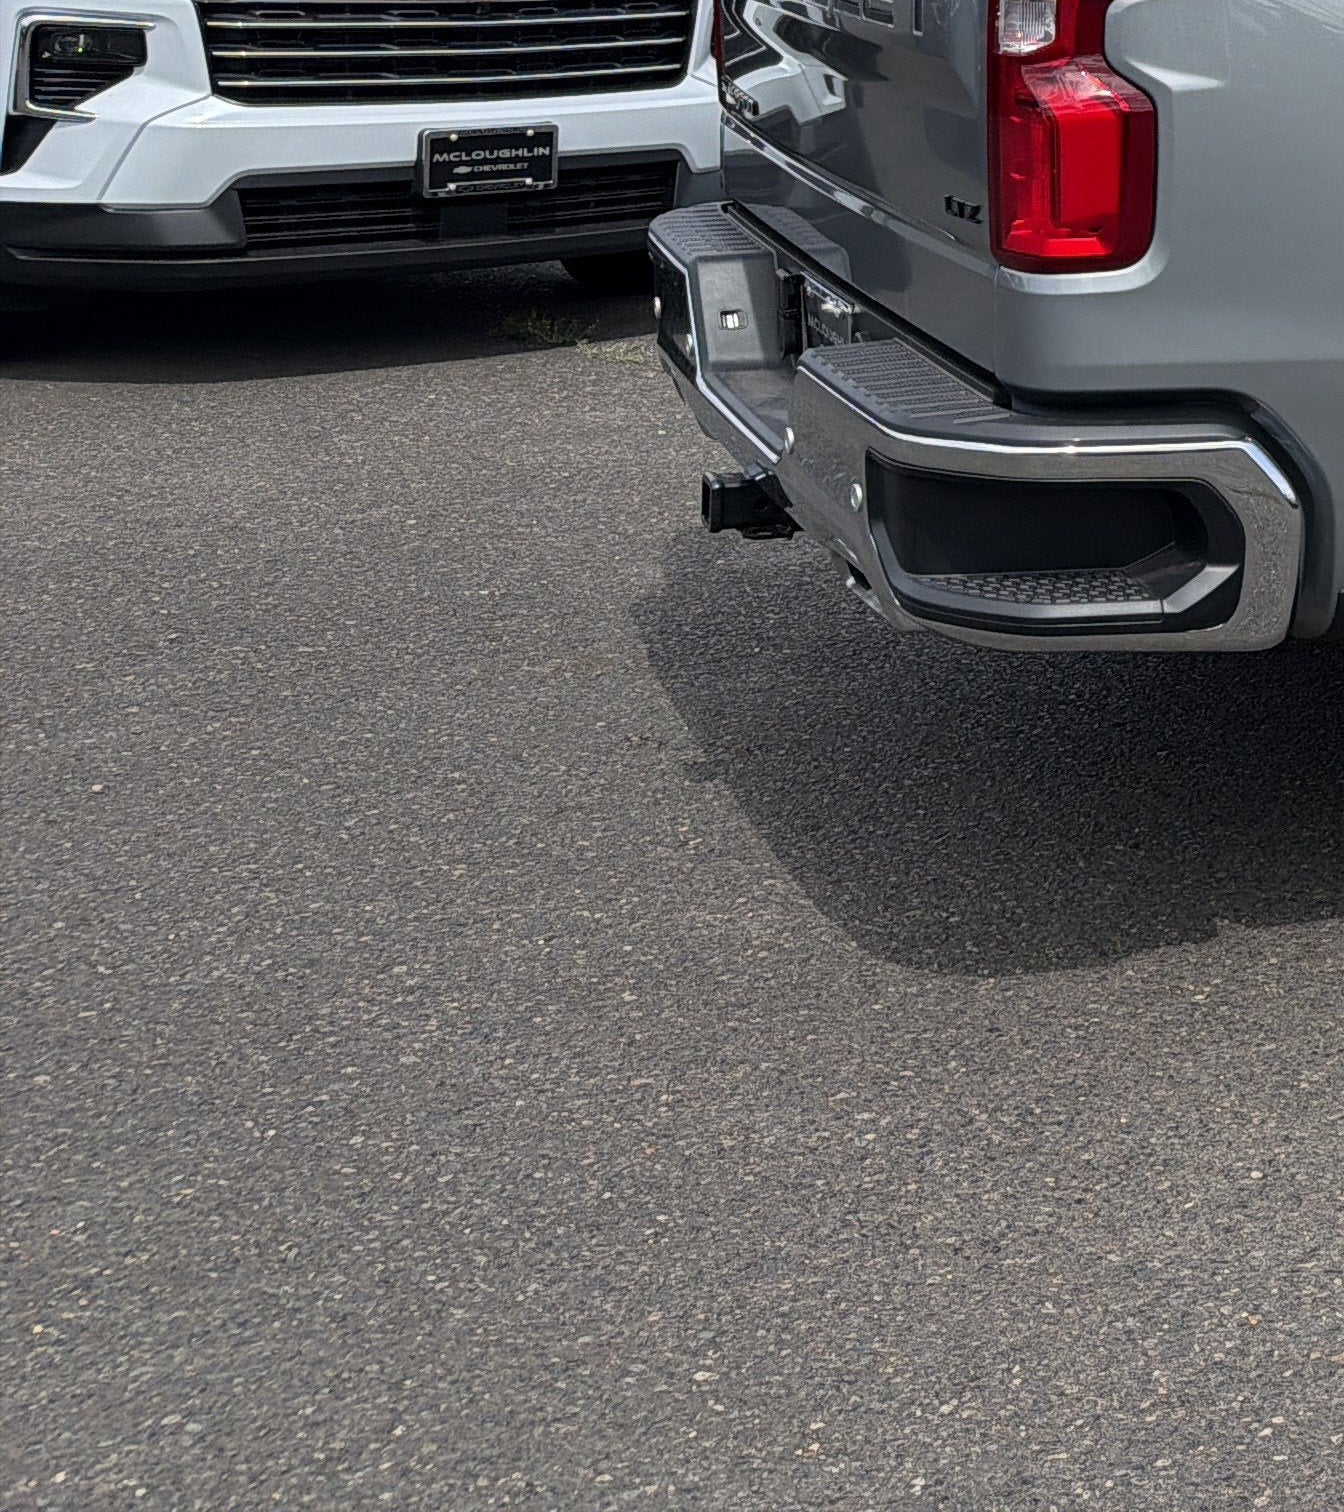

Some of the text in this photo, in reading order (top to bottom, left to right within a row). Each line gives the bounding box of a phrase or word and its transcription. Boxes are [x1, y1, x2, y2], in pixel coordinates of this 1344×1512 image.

[432, 146, 551, 163] MCLOUGHLIN
[473, 162, 530, 173] CHEVROLET
[944, 194, 984, 225] LTZ
